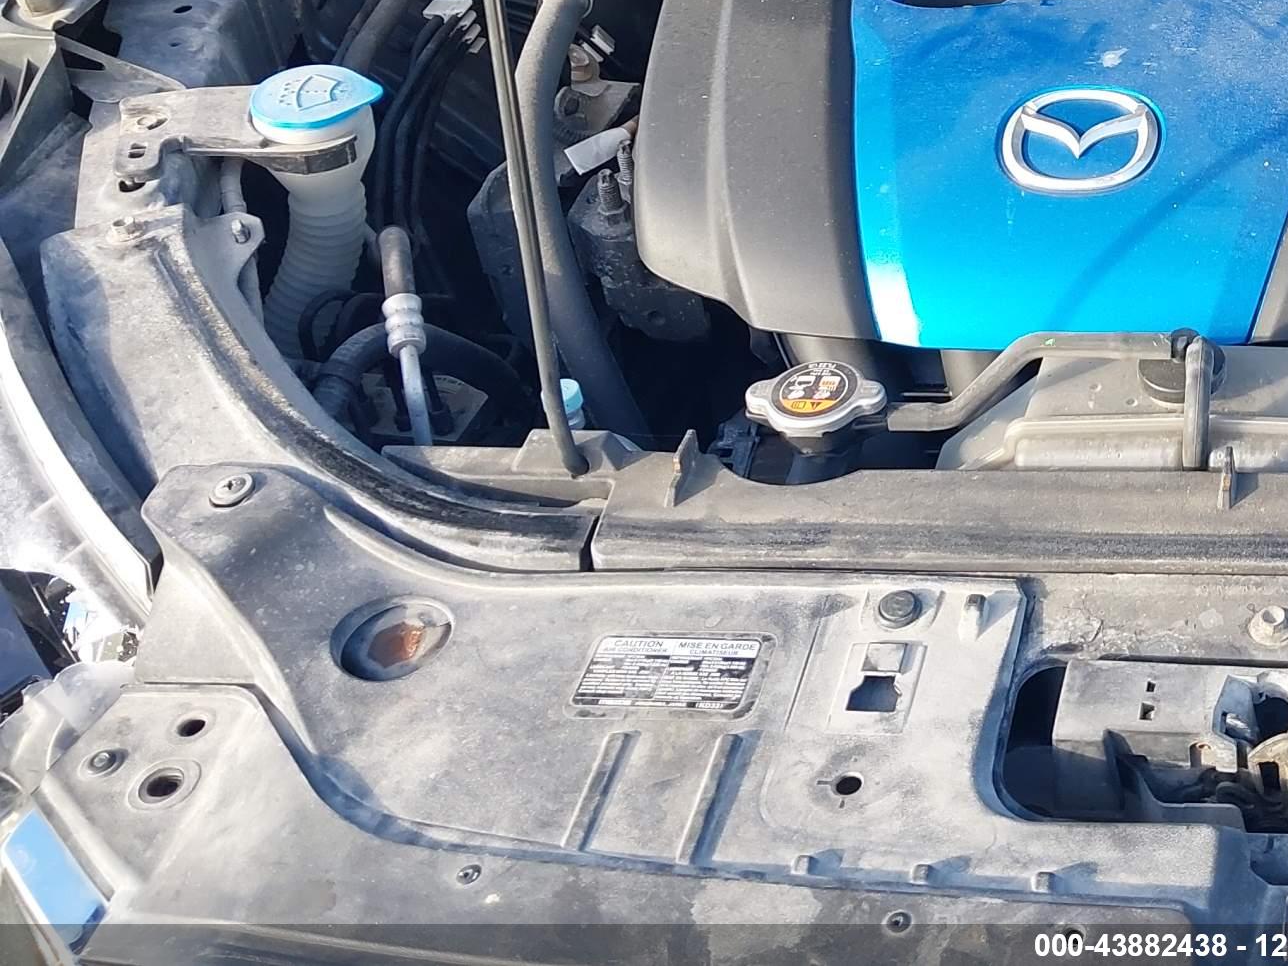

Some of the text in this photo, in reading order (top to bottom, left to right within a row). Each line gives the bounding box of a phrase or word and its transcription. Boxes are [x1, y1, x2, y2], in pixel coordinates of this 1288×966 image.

[614, 639, 664, 648] CAUTION
[678, 641, 757, 651] MISE EN GARDE
